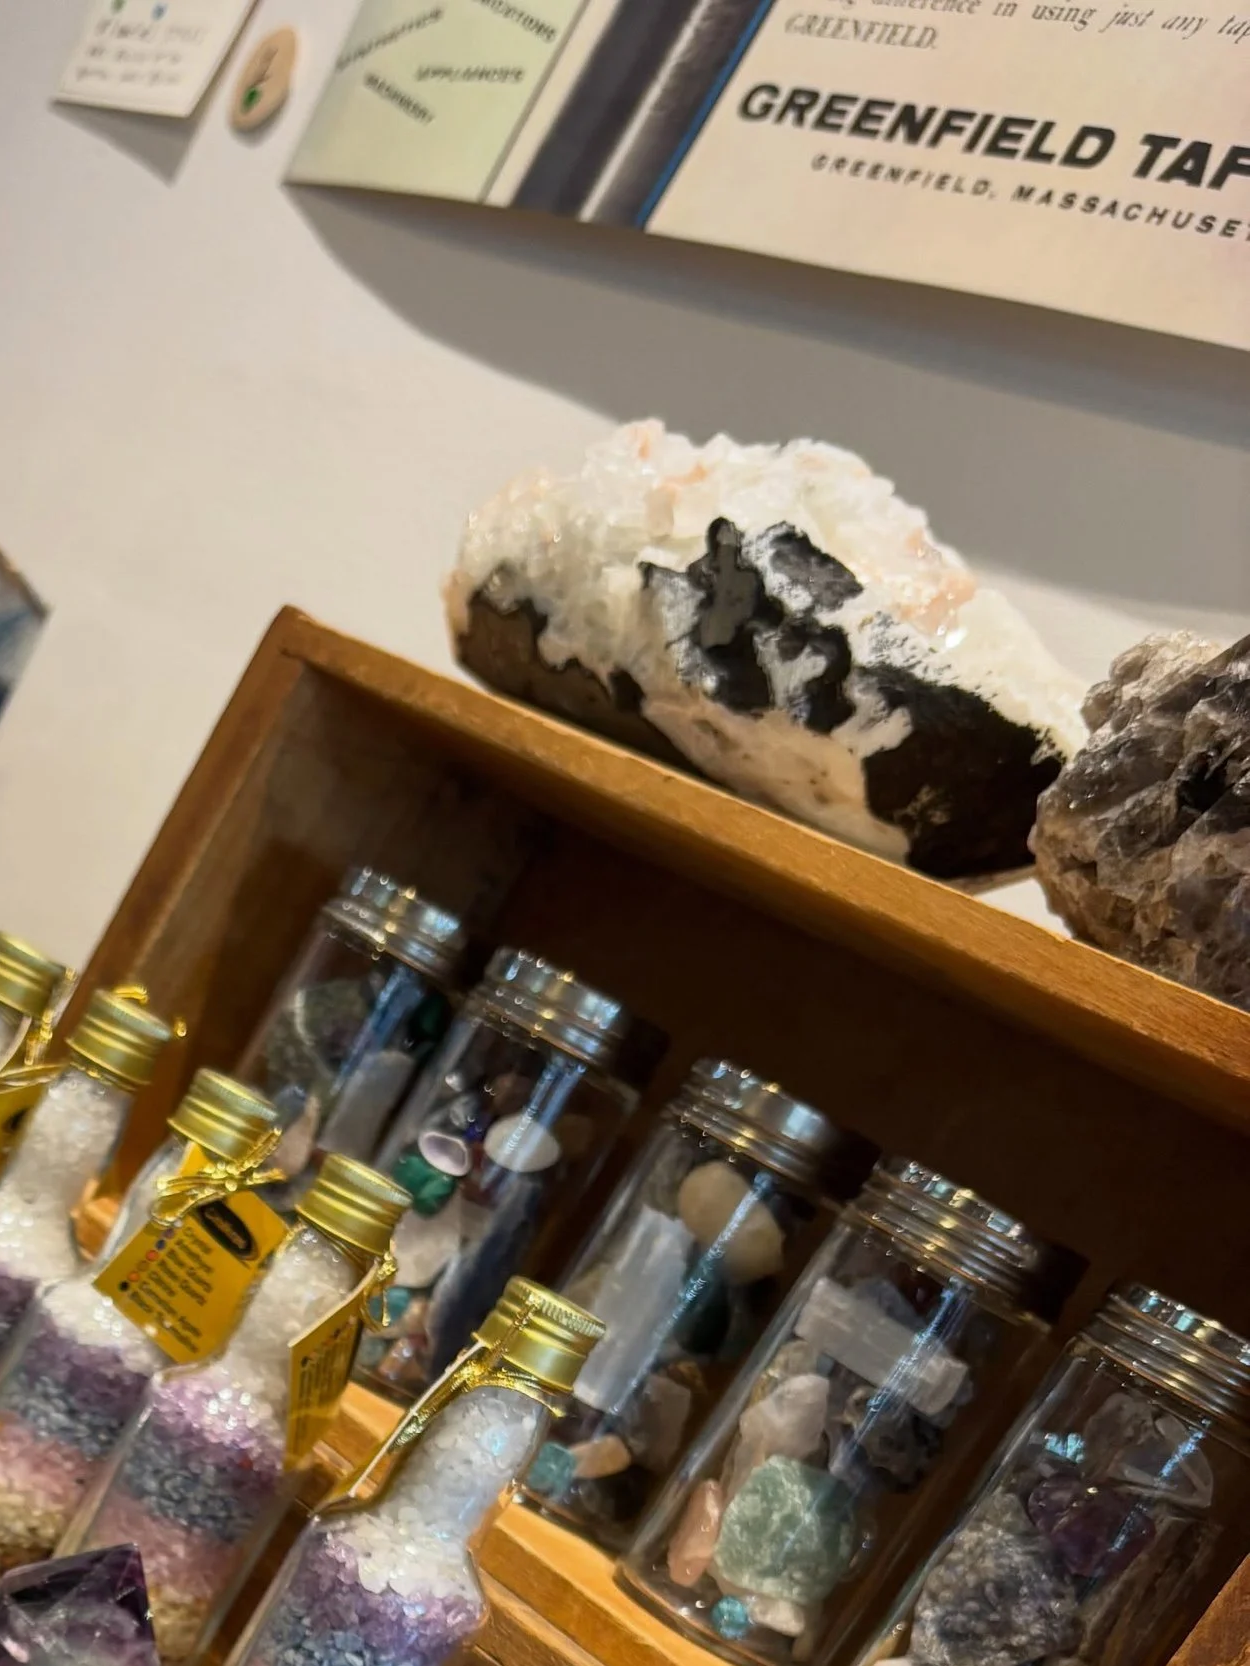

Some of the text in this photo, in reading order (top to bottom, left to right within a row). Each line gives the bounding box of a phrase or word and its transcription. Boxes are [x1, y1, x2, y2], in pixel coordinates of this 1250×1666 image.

[1031, 0, 1097, 32] using
[1098, 3, 1155, 34] just
[1161, 15, 1208, 41] any
[737, 84, 1116, 169] GREENFIELD
[811, 153, 1250, 242] GREENFIELD, MASSACHUSE
